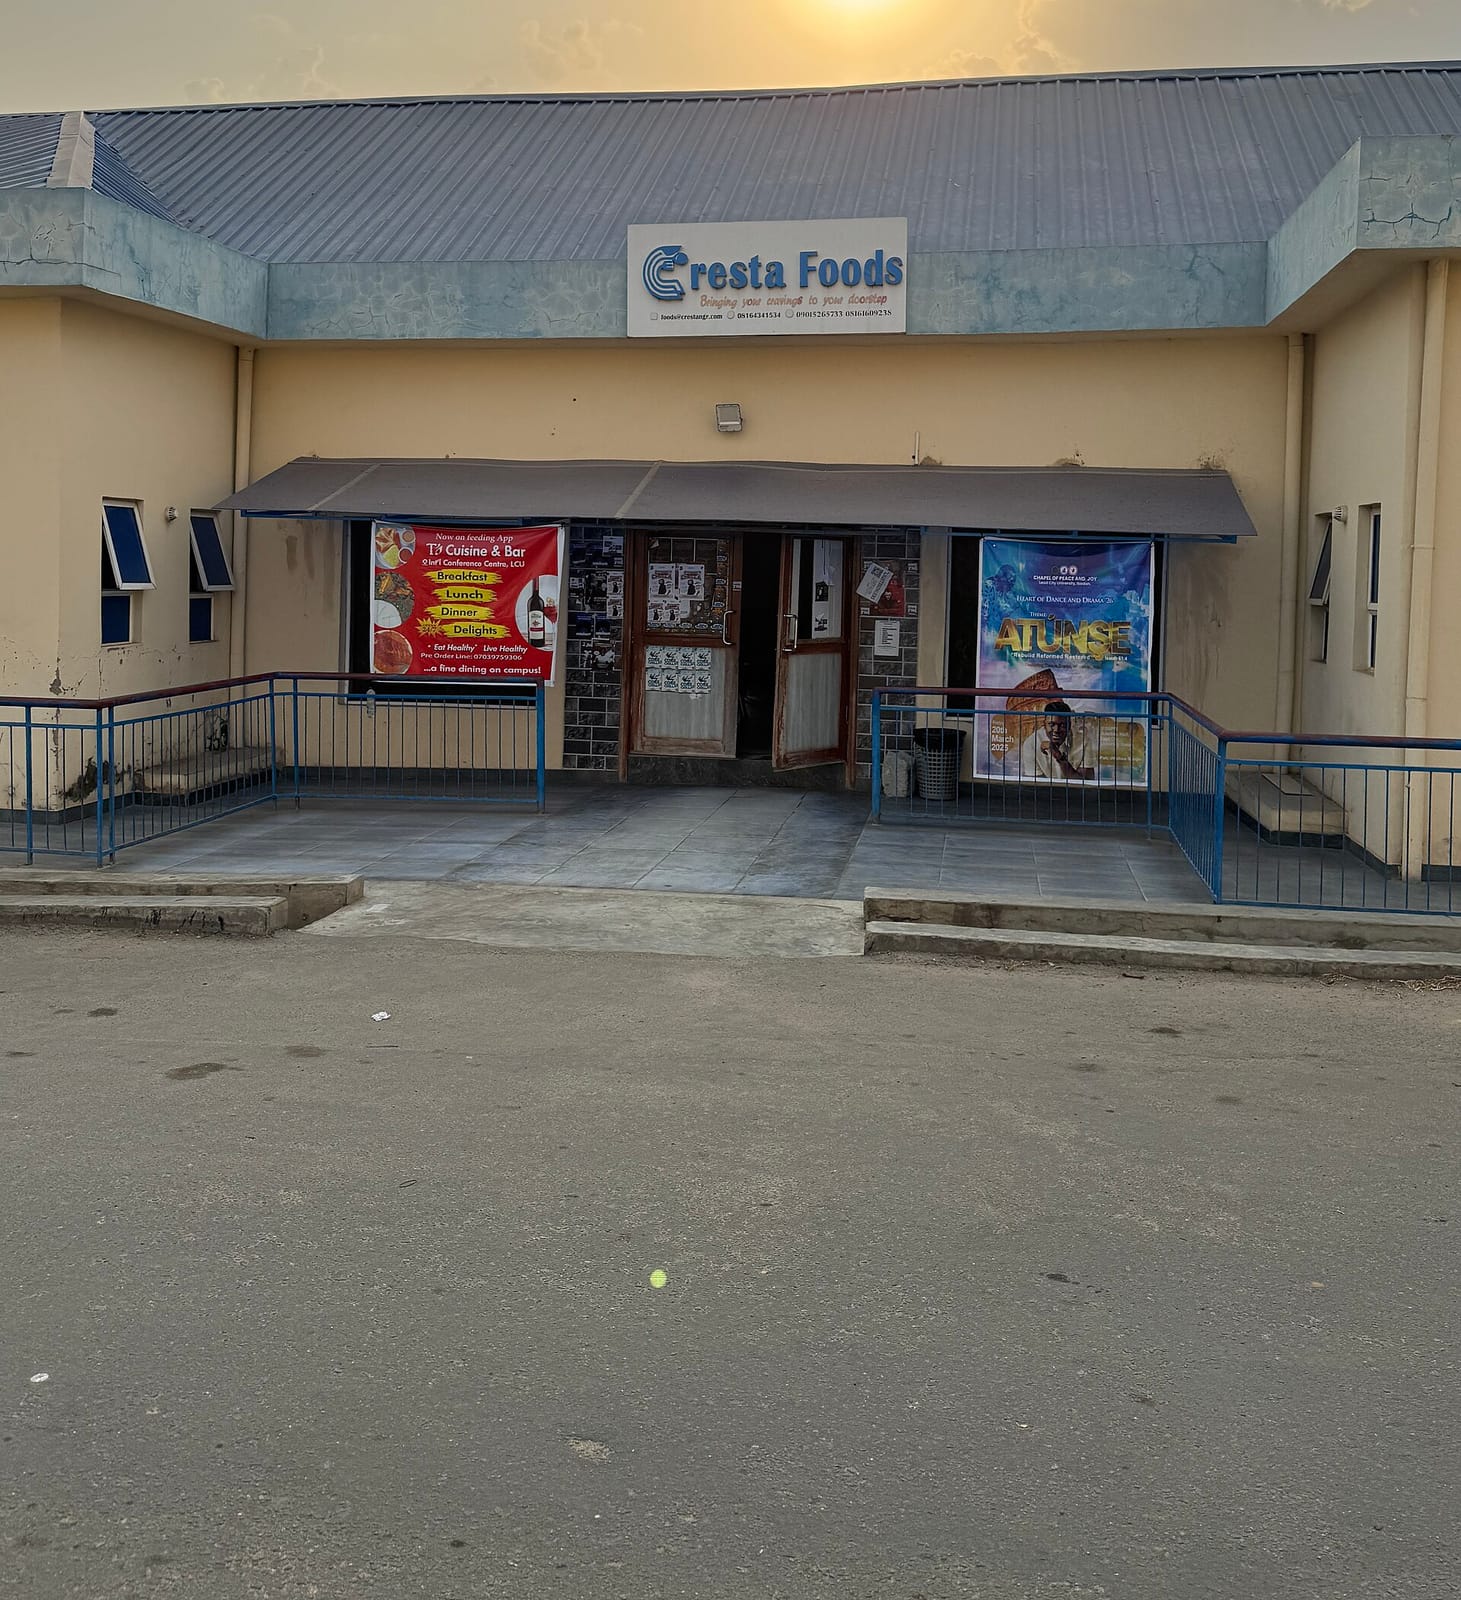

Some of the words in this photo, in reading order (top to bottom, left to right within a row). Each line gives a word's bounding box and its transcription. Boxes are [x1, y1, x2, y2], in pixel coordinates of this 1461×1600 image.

[799, 249, 903, 289] Foods
[700, 294, 738, 310] Bringing
[742, 297, 762, 309] your
[766, 294, 803, 308] cravings
[808, 295, 818, 305] to
[822, 296, 843, 307] your
[848, 293, 888, 305] doorstep
[435, 533, 455, 541] Now
[466, 533, 495, 543] feeding
[496, 534, 514, 543] App
[445, 544, 488, 557] Cuisine
[491, 545, 501, 557] &
[504, 545, 526, 558] Bar
[443, 559, 482, 568] Conference
[483, 560, 509, 568] Centre,
[510, 560, 525, 568] LCU
[437, 571, 488, 581] Breakfast
[446, 590, 483, 599] Lunch
[441, 607, 478, 616] Dinner
[453, 625, 497, 636] Delights
[499, 645, 528, 654] Healthy
[439, 664, 456, 672] fine
[459, 665, 487, 674] dining
[503, 666, 541, 675] campus!
[991, 734, 1014, 743] March
